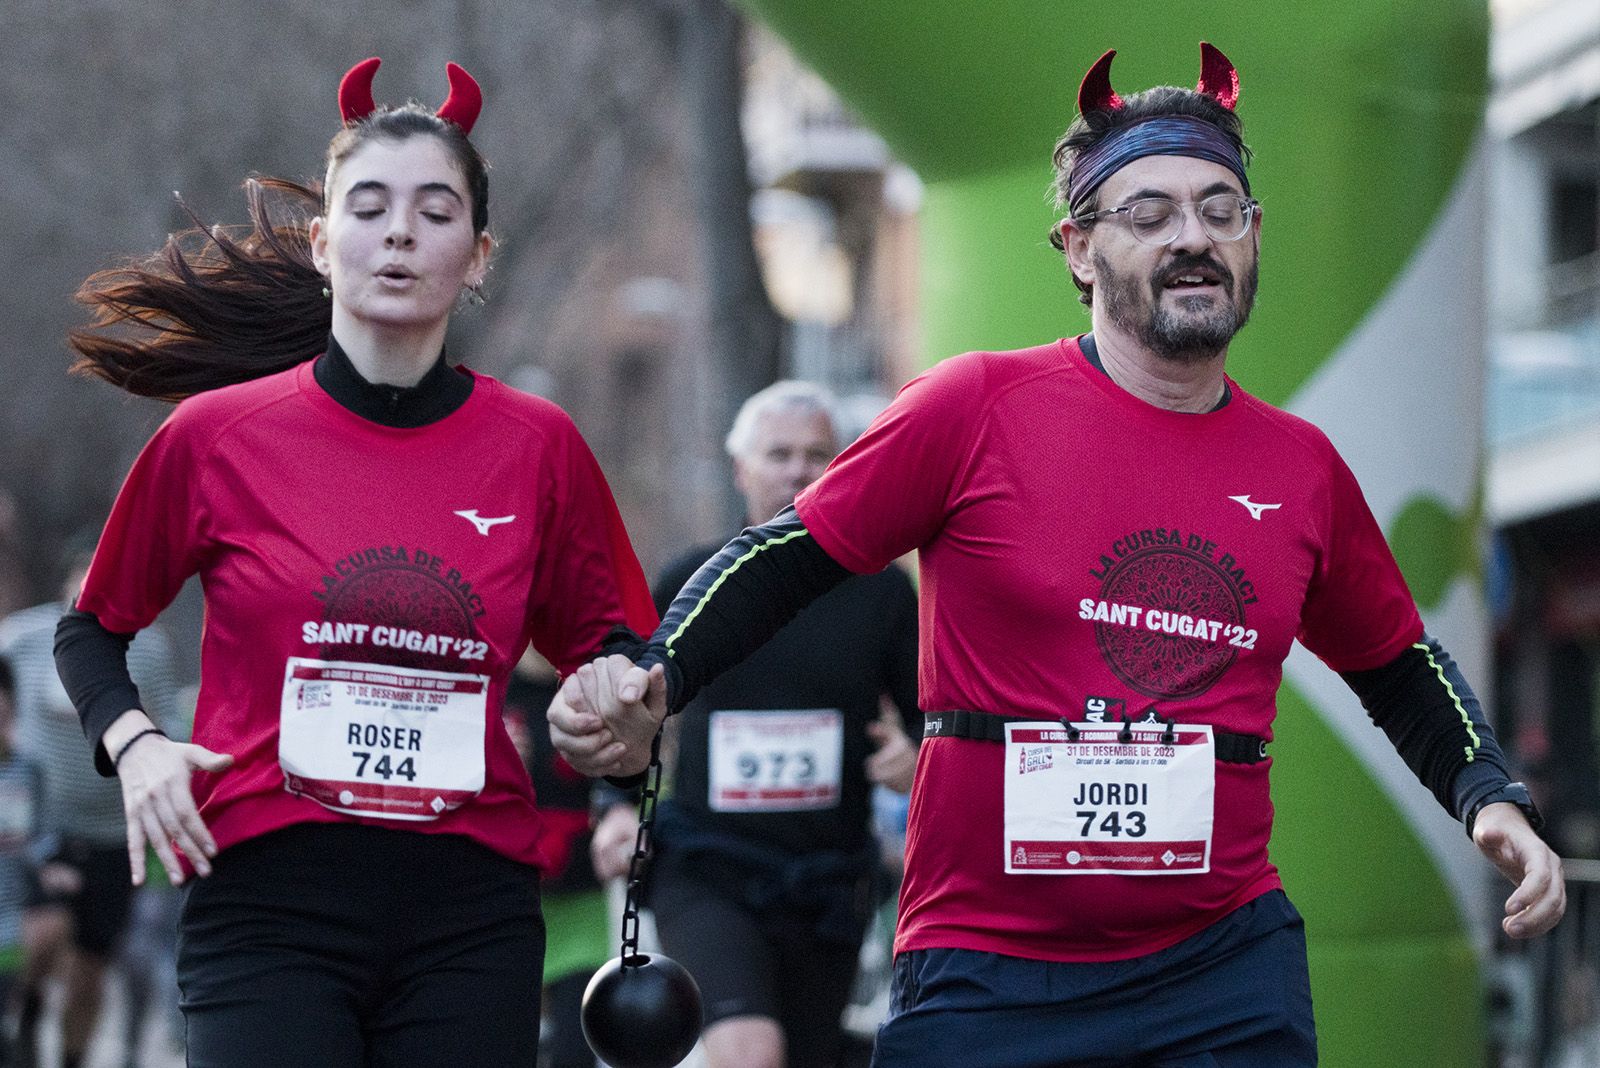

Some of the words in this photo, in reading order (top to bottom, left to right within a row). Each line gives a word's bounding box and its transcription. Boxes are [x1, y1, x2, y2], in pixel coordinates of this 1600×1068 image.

[335, 545, 410, 577] CURSA
[414, 549, 444, 574] DE
[1089, 555, 1115, 581] LA
[1112, 527, 1183, 558] CURSA
[1187, 533, 1218, 559] DE
[1078, 598, 1142, 627] SANT
[302, 621, 369, 645] SANT
[348, 723, 422, 751] ROSER
[352, 751, 417, 781] 744
[1067, 746, 1077, 757] 31
[1080, 746, 1091, 757] DE
[1093, 746, 1138, 757] DESEMBRE
[1141, 746, 1151, 757] DE
[1154, 747, 1175, 758] 2023
[1073, 783, 1148, 806] JORDI
[1076, 811, 1147, 838] 743
